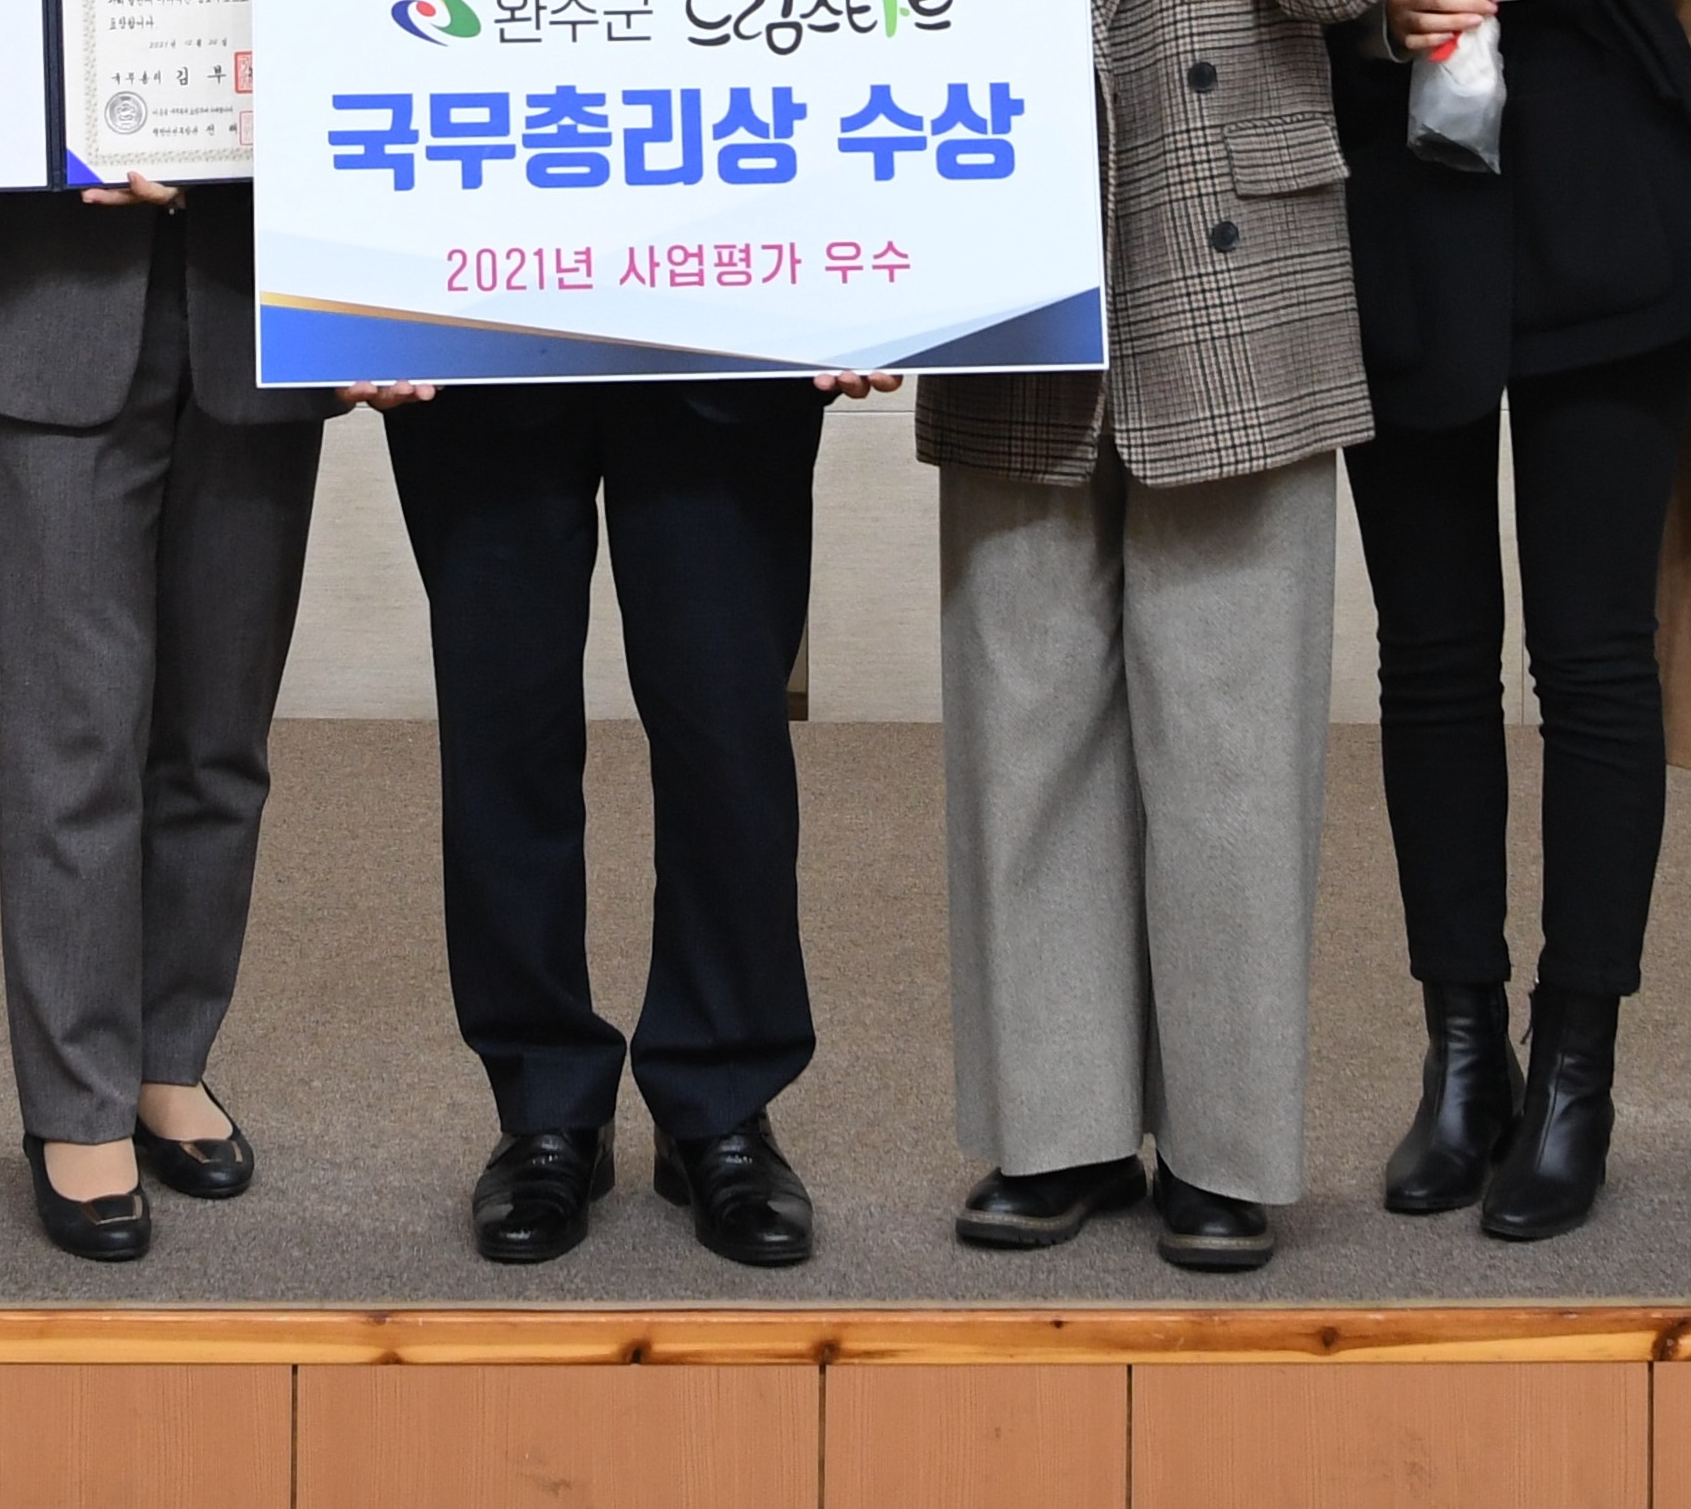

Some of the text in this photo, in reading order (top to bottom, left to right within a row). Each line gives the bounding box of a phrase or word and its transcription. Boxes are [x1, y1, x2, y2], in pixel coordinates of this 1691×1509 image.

[328, 82, 1025, 191] 국무총리상 수상
[447, 240, 911, 292] 2021년 사업평가 우수
